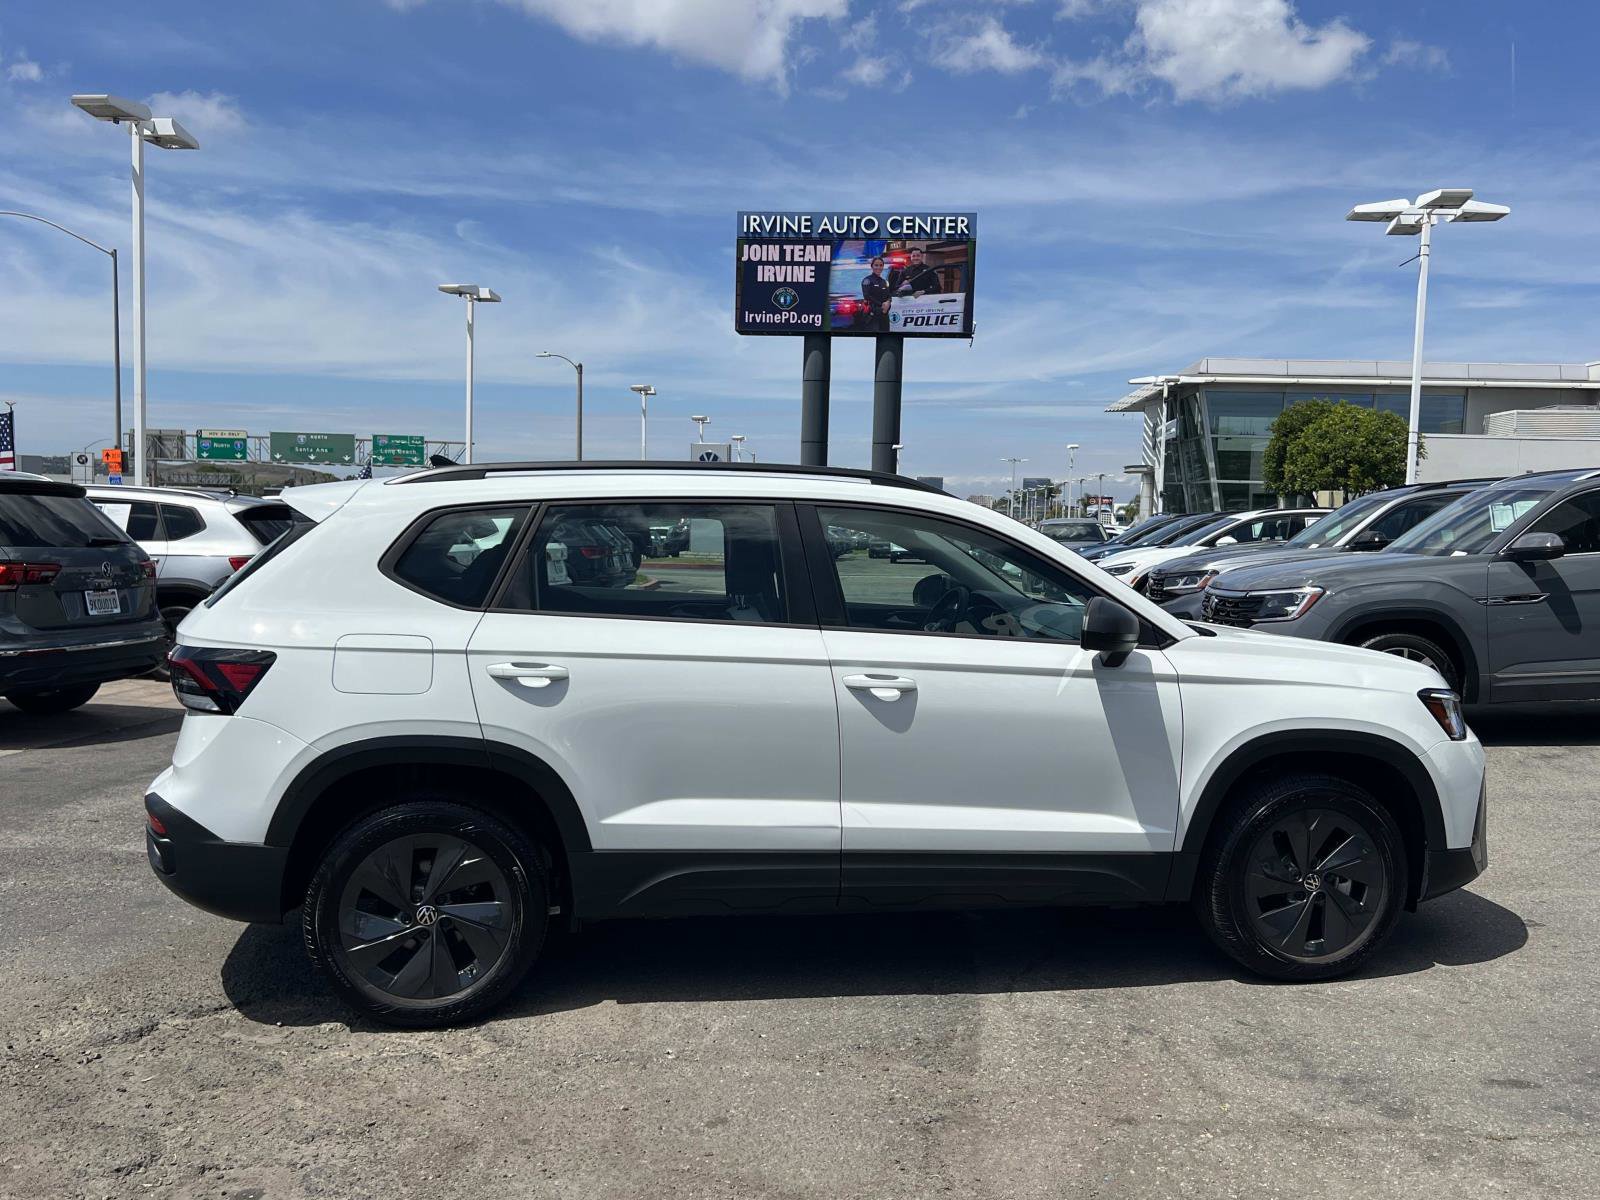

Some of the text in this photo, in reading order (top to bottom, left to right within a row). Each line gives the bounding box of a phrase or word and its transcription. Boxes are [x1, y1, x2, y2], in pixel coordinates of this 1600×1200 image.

[743, 215, 969, 234] IRVINE AUTO CENTER
[742, 244, 831, 262] JOIN TEAM
[757, 265, 815, 282] IRVINE
[745, 311, 822, 326] IrvinePD.org
[902, 314, 960, 328] POLICE
